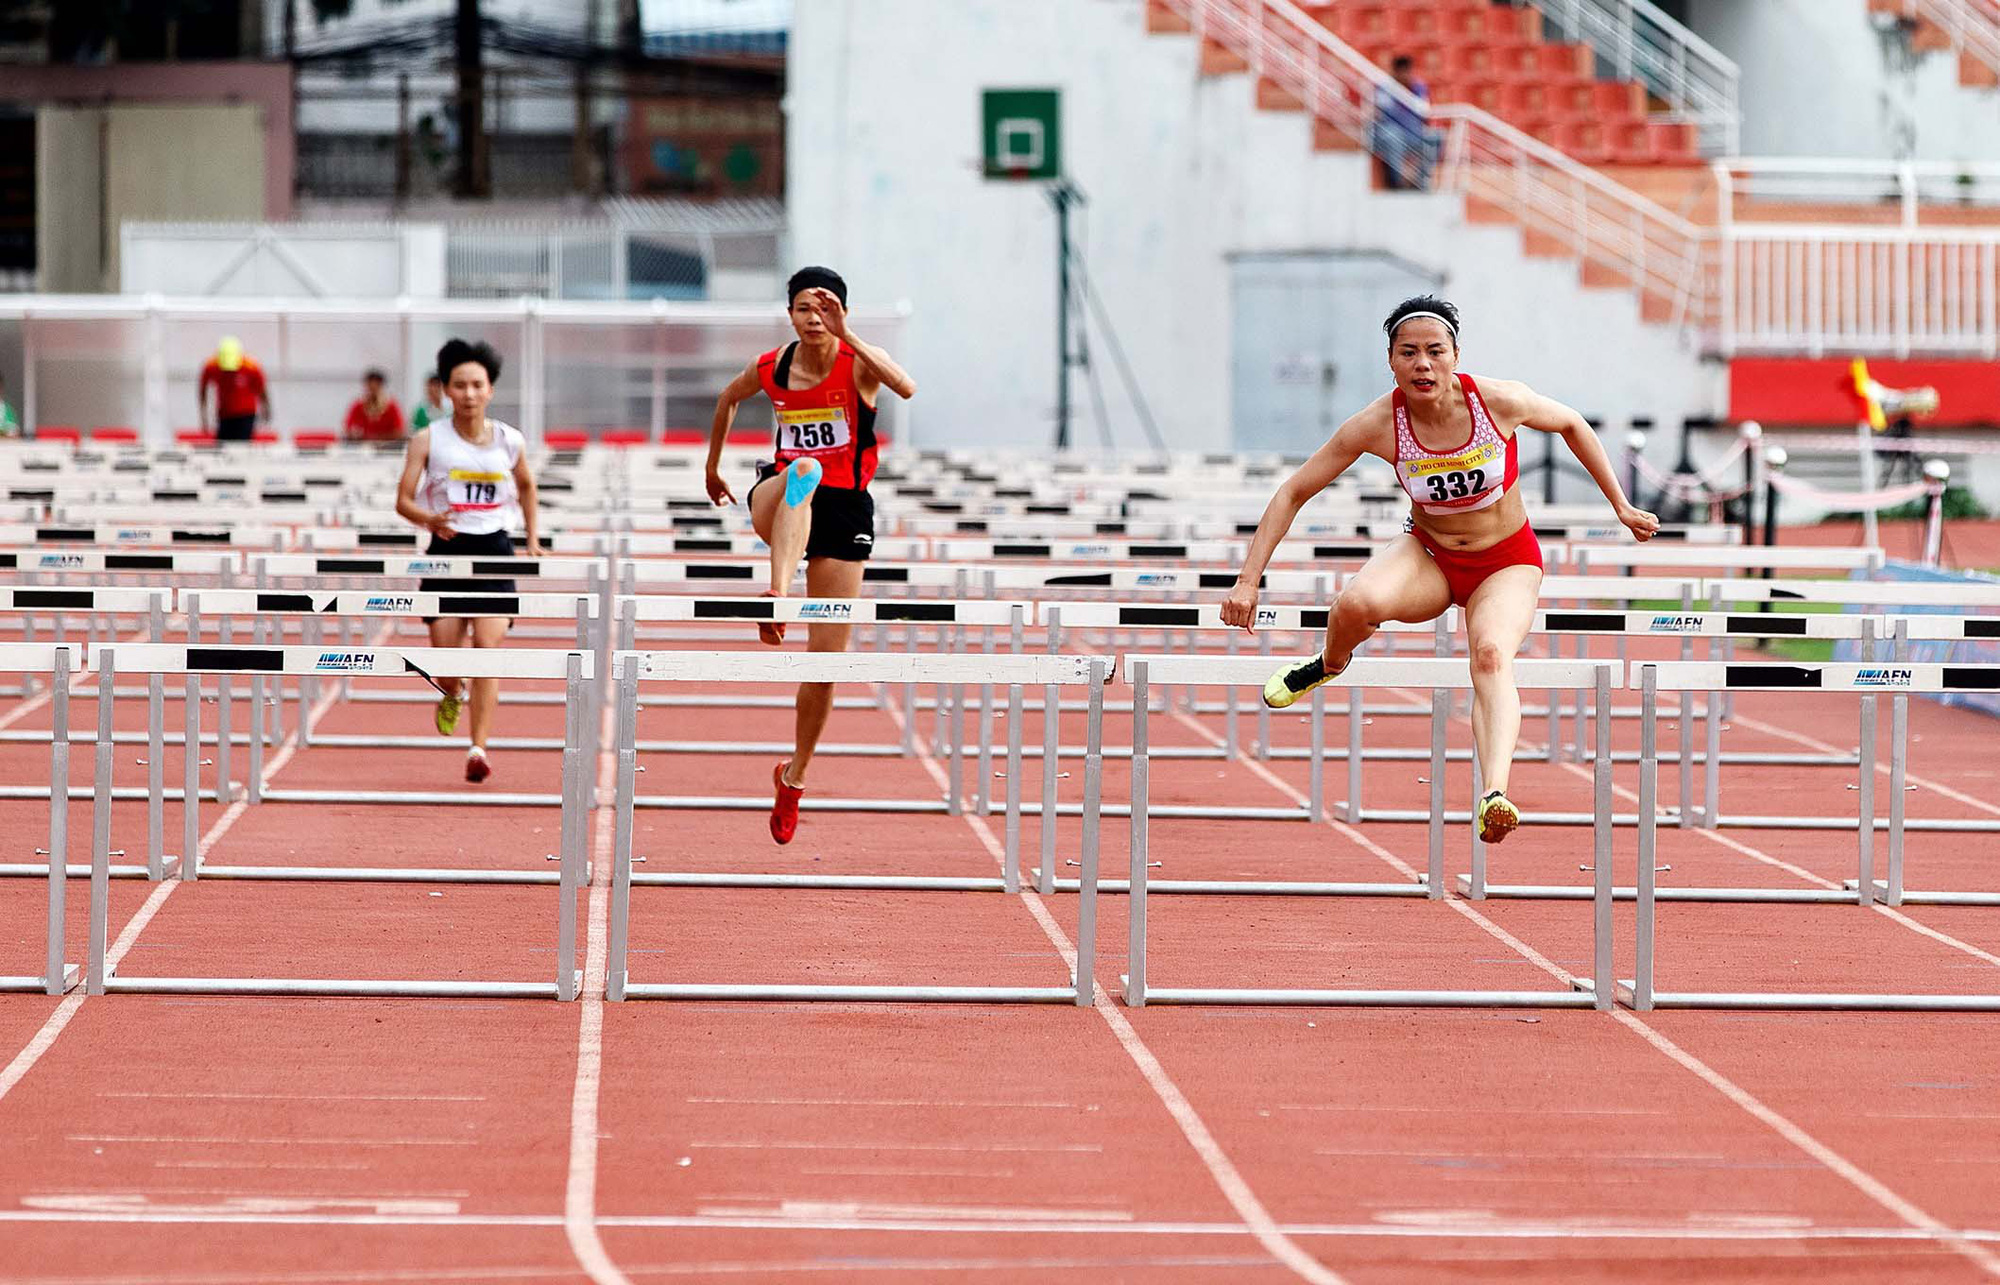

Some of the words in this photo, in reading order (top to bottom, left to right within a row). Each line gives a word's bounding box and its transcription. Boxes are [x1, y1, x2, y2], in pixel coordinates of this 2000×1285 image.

[790, 422, 835, 448] 258
[1465, 453, 1482, 465] CITY
[465, 483, 496, 503] 179
[1426, 469, 1488, 501] 332
